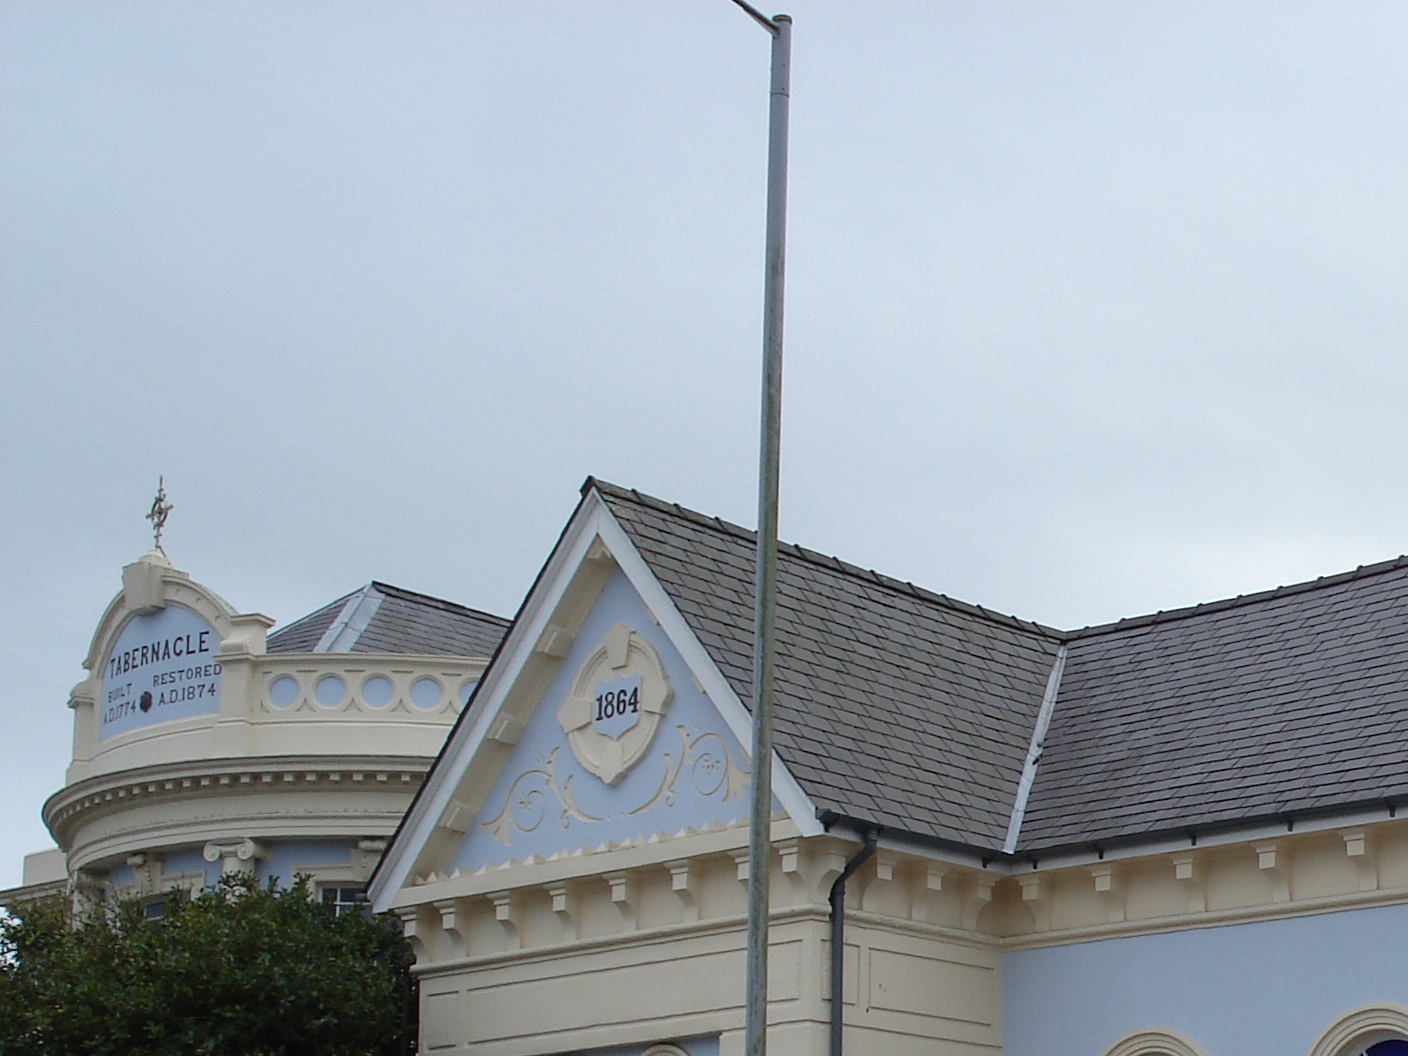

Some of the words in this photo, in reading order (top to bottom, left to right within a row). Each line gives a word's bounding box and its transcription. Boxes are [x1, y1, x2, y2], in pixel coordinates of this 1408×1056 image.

[110, 630, 210, 679] TABERNACLE
[153, 663, 222, 688] RESTORED
[595, 687, 639, 722] 1864
